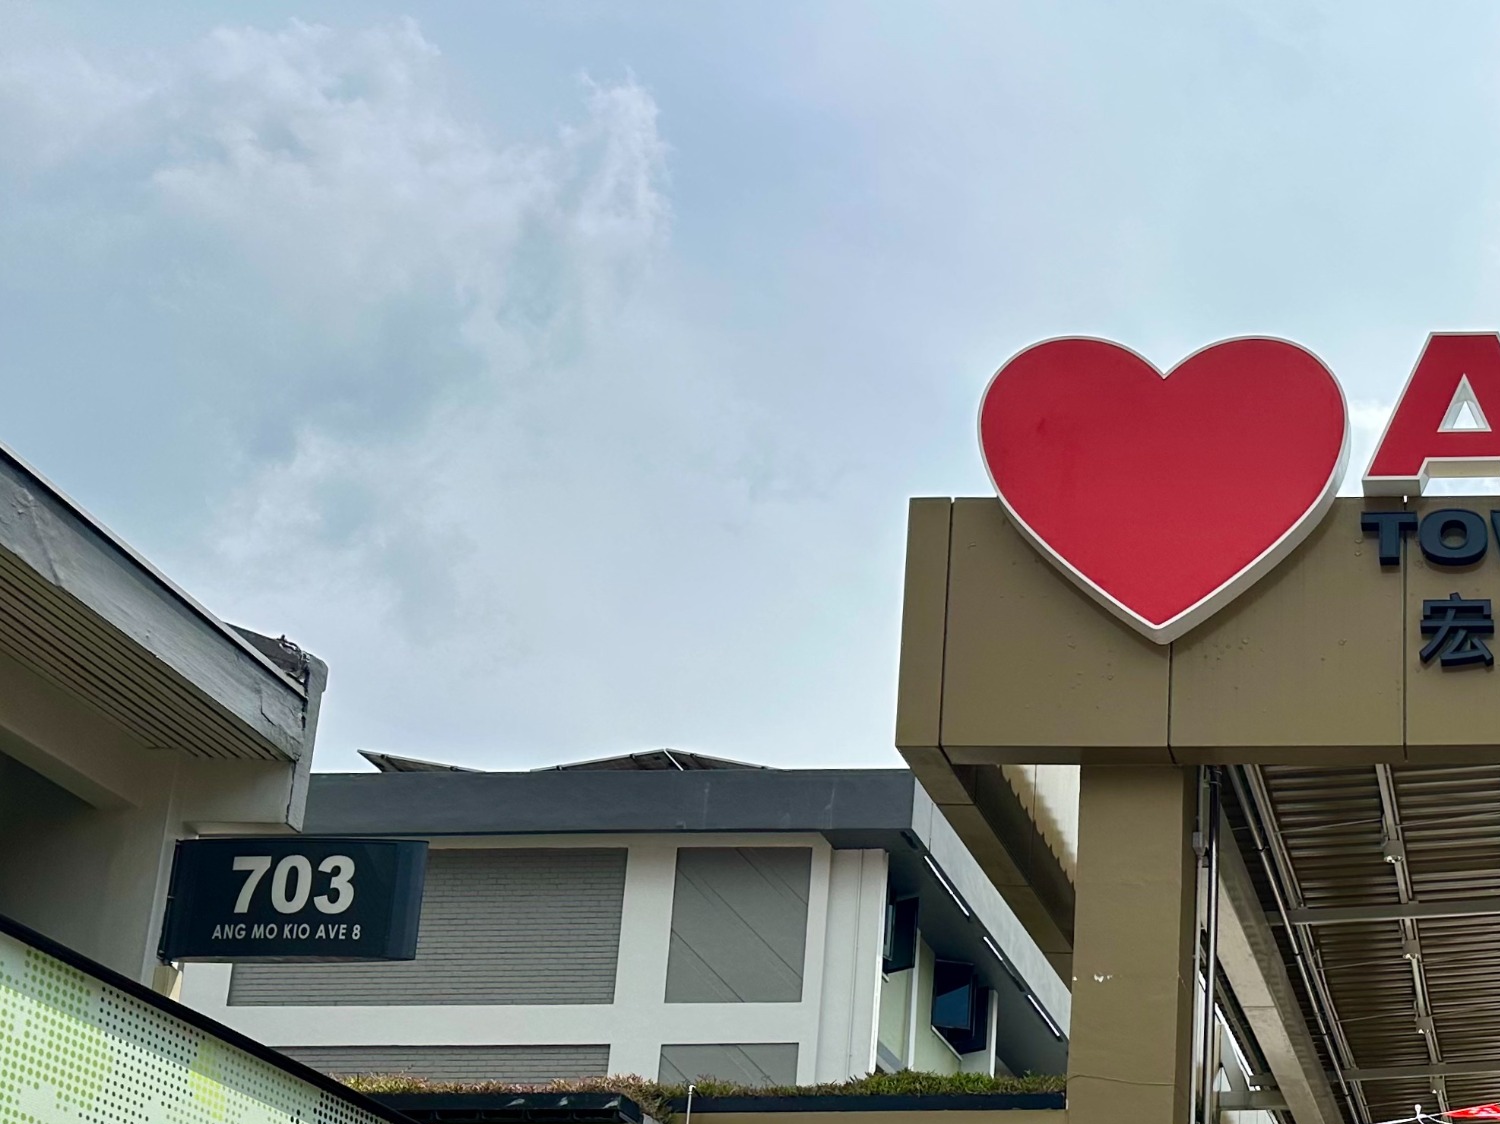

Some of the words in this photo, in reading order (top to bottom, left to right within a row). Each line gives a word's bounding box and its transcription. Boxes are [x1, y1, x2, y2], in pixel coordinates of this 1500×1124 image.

[231, 854, 356, 915] 703
[211, 923, 247, 940] ANG
[251, 923, 278, 940] MO
[282, 923, 311, 940] KIO
[315, 923, 347, 940] AVE
[351, 923, 362, 940] 8
